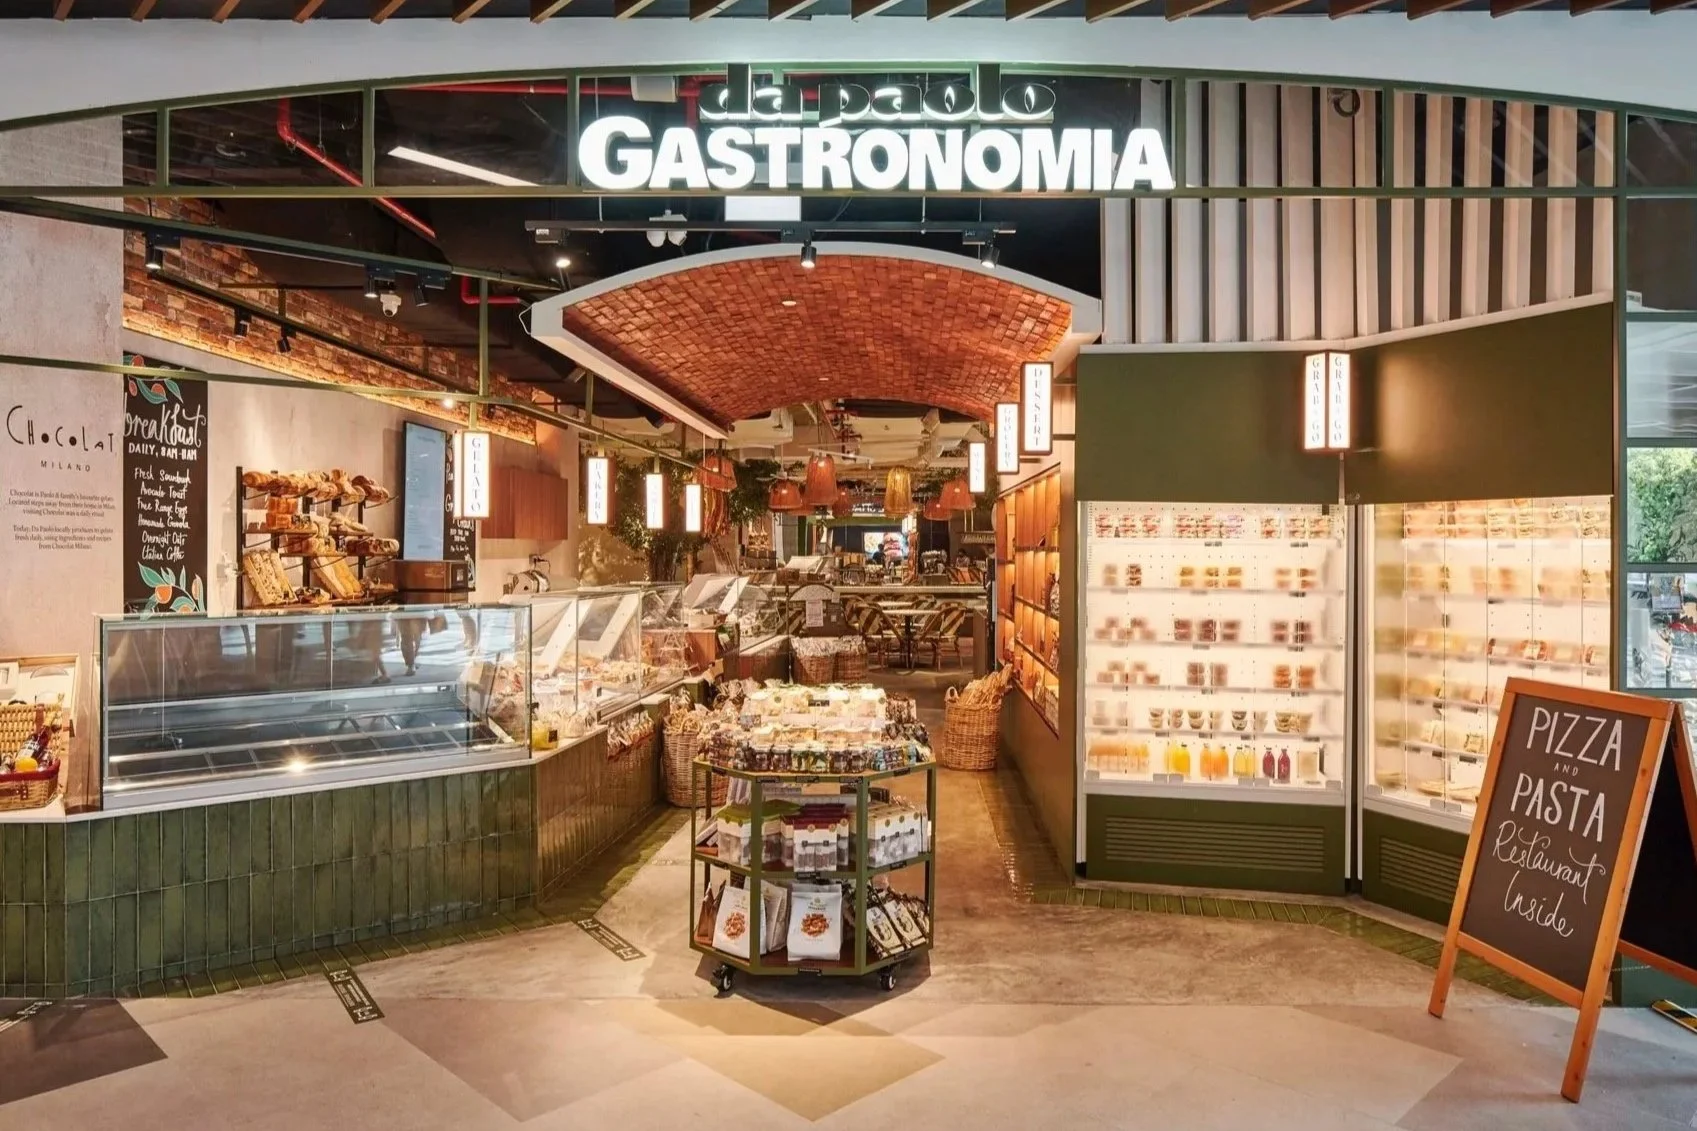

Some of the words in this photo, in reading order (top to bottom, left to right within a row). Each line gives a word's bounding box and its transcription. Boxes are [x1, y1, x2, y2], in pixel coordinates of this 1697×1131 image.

[700, 63, 804, 122] da
[817, 63, 1057, 129] paolo
[577, 115, 1176, 191] GASTRONOMIA
[1034, 366, 1044, 447] DESSERT
[1312, 357, 1320, 404] GRAB
[40, 460, 91, 472] MILANO
[134, 464, 154, 481] Fresh
[168, 485, 188, 500] Toast
[471, 437, 482, 513] GELATO
[137, 496, 152, 510] Free
[142, 530, 171, 548] Overnight
[1526, 706, 1623, 771] PIZZA
[1554, 763, 1579, 777] AND
[1510, 772, 1606, 843] PASTA
[1492, 819, 1606, 905] Restaurant
[1503, 870, 1574, 938] Inside
